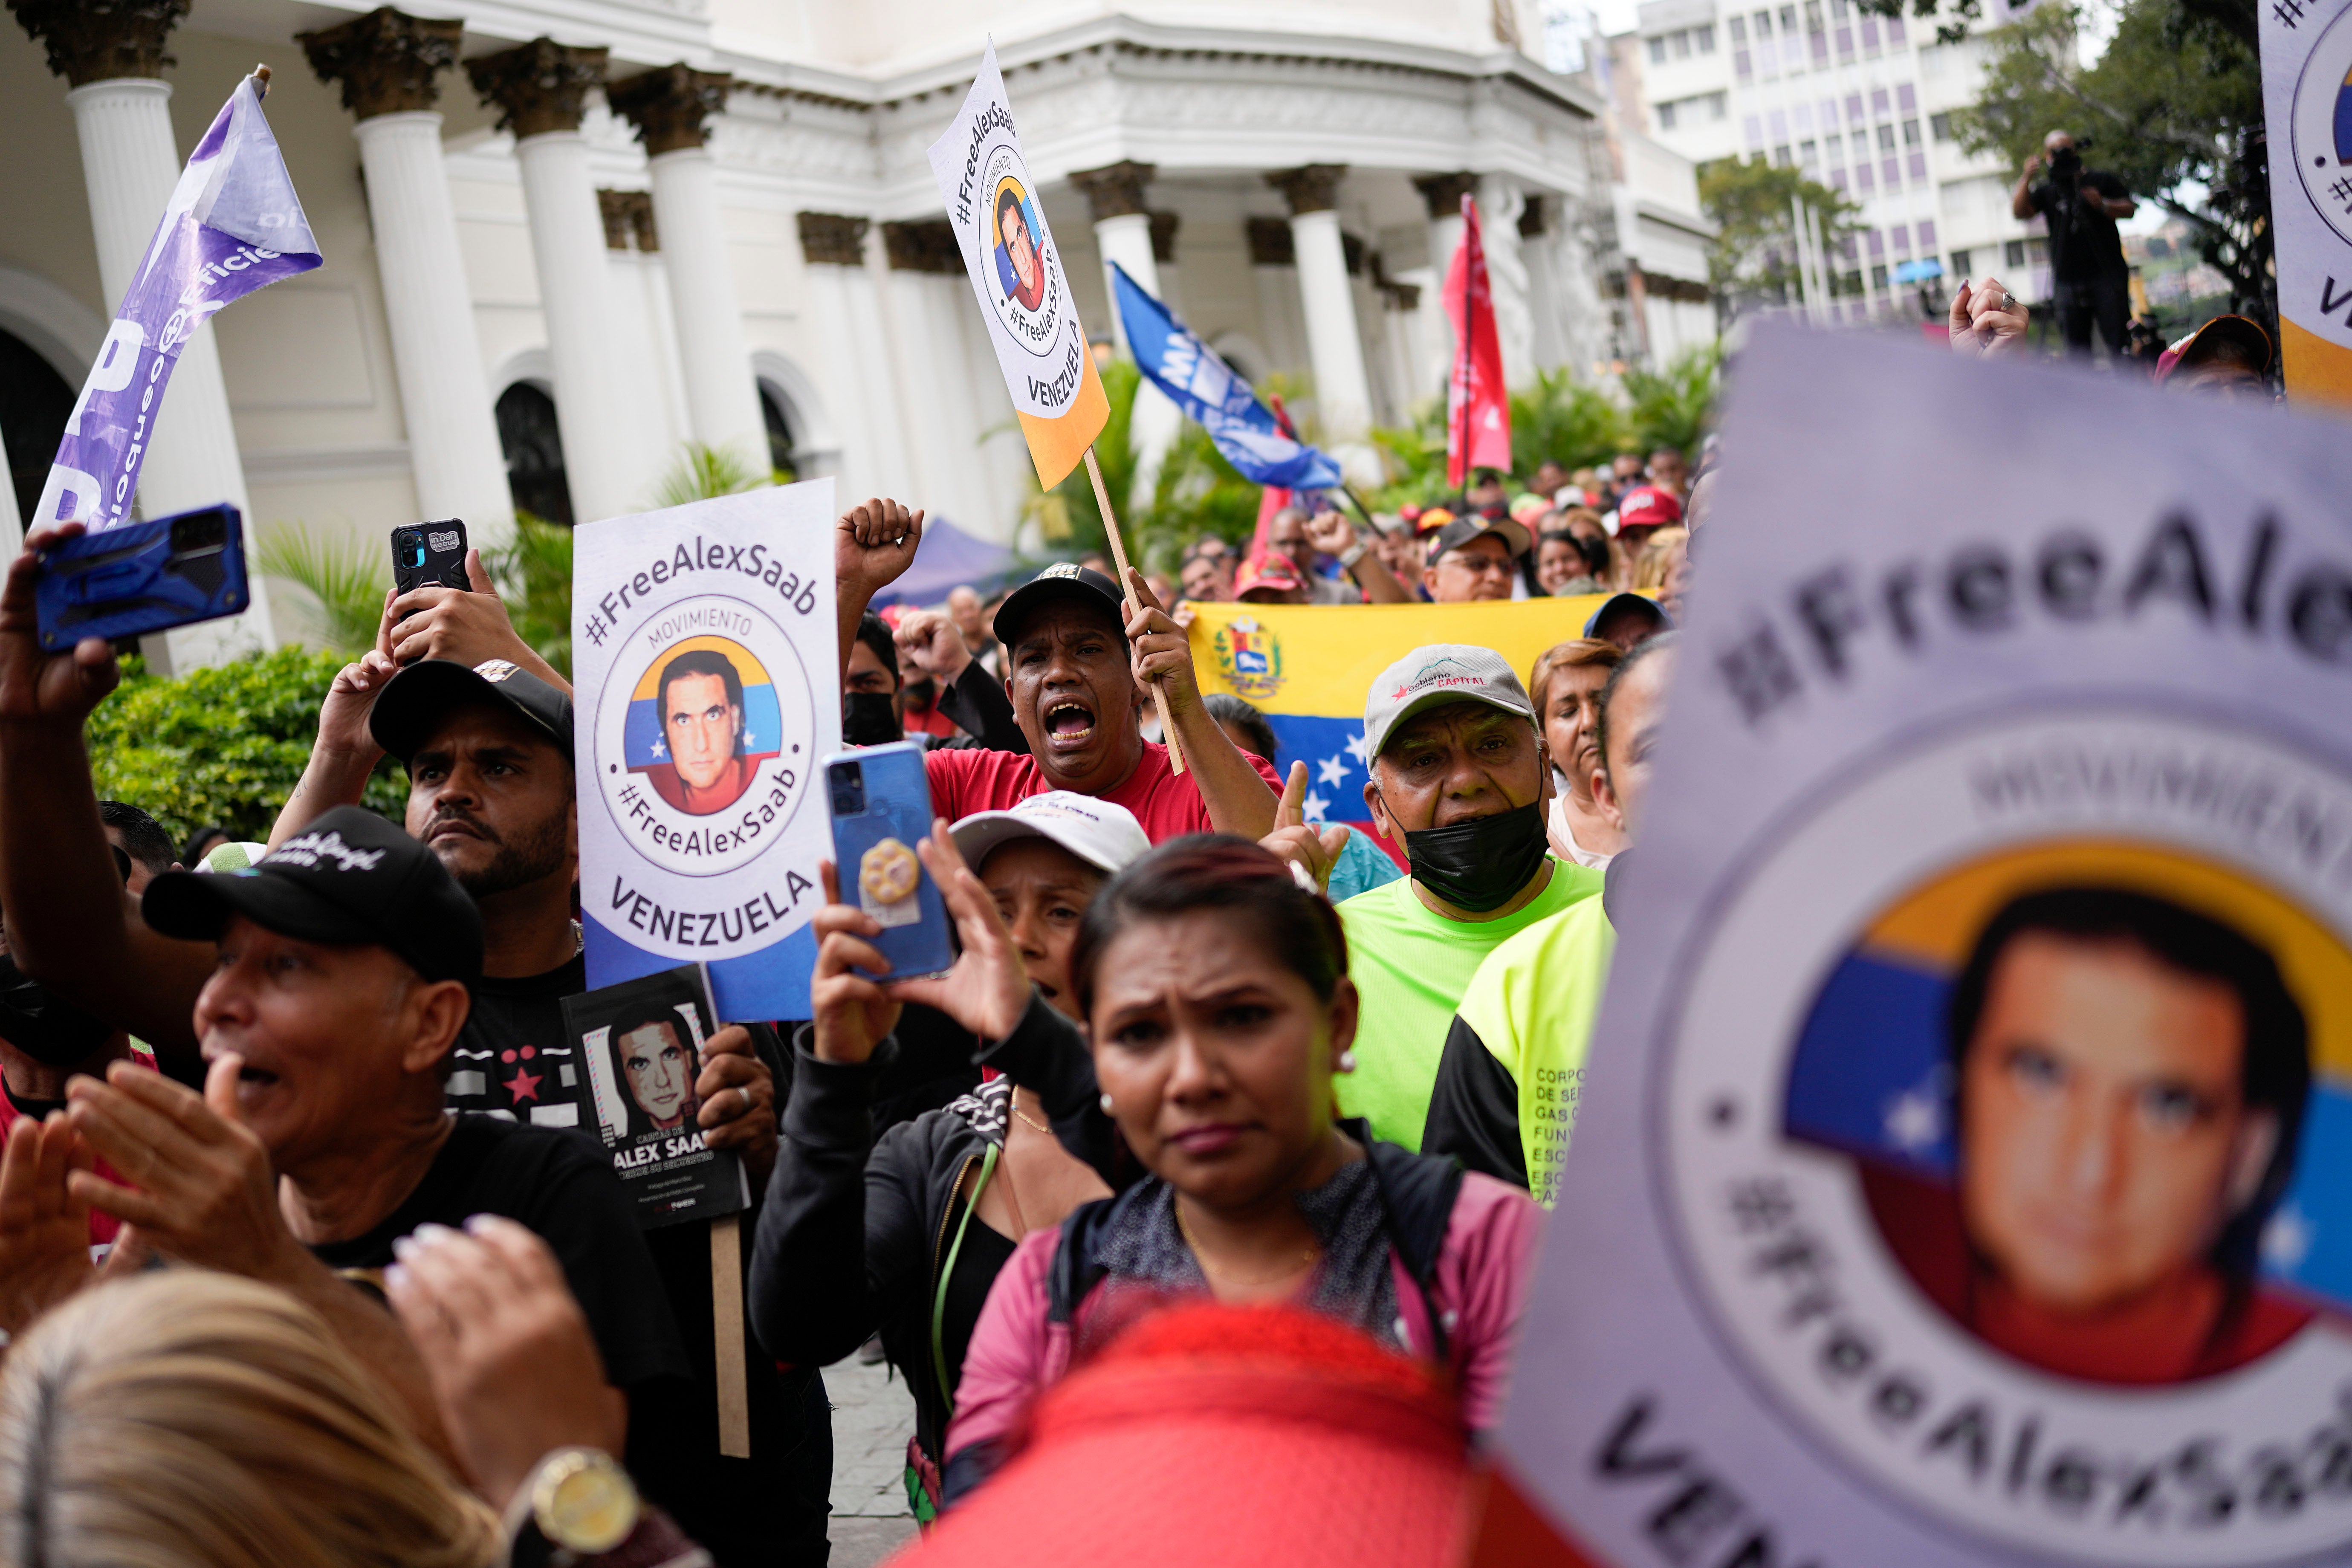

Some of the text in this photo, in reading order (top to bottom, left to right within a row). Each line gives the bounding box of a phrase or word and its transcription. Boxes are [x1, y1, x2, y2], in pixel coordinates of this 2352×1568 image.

[957, 101, 1015, 225] #FreeAlexSaab
[985, 156, 1010, 207] MOVIMIENTO
[1010, 249, 1056, 341] #FreeAlexSaab
[1027, 319, 1079, 408] VENEZUELA
[586, 535, 816, 646] #FreeAlexSaab
[1043, 564, 1078, 576] FREE
[648, 608, 752, 649] MOVIMIENTO
[1409, 673, 1450, 691] Gobierno
[1437, 677, 1487, 688] CAPITAL
[618, 769, 795, 856] #FreeAlexSaab
[611, 871, 813, 946] VENEZUELA
[1535, 1107, 1568, 1122] GAS
[1537, 1086, 1554, 1102] DE
[614, 1143, 661, 1169] ALEX
